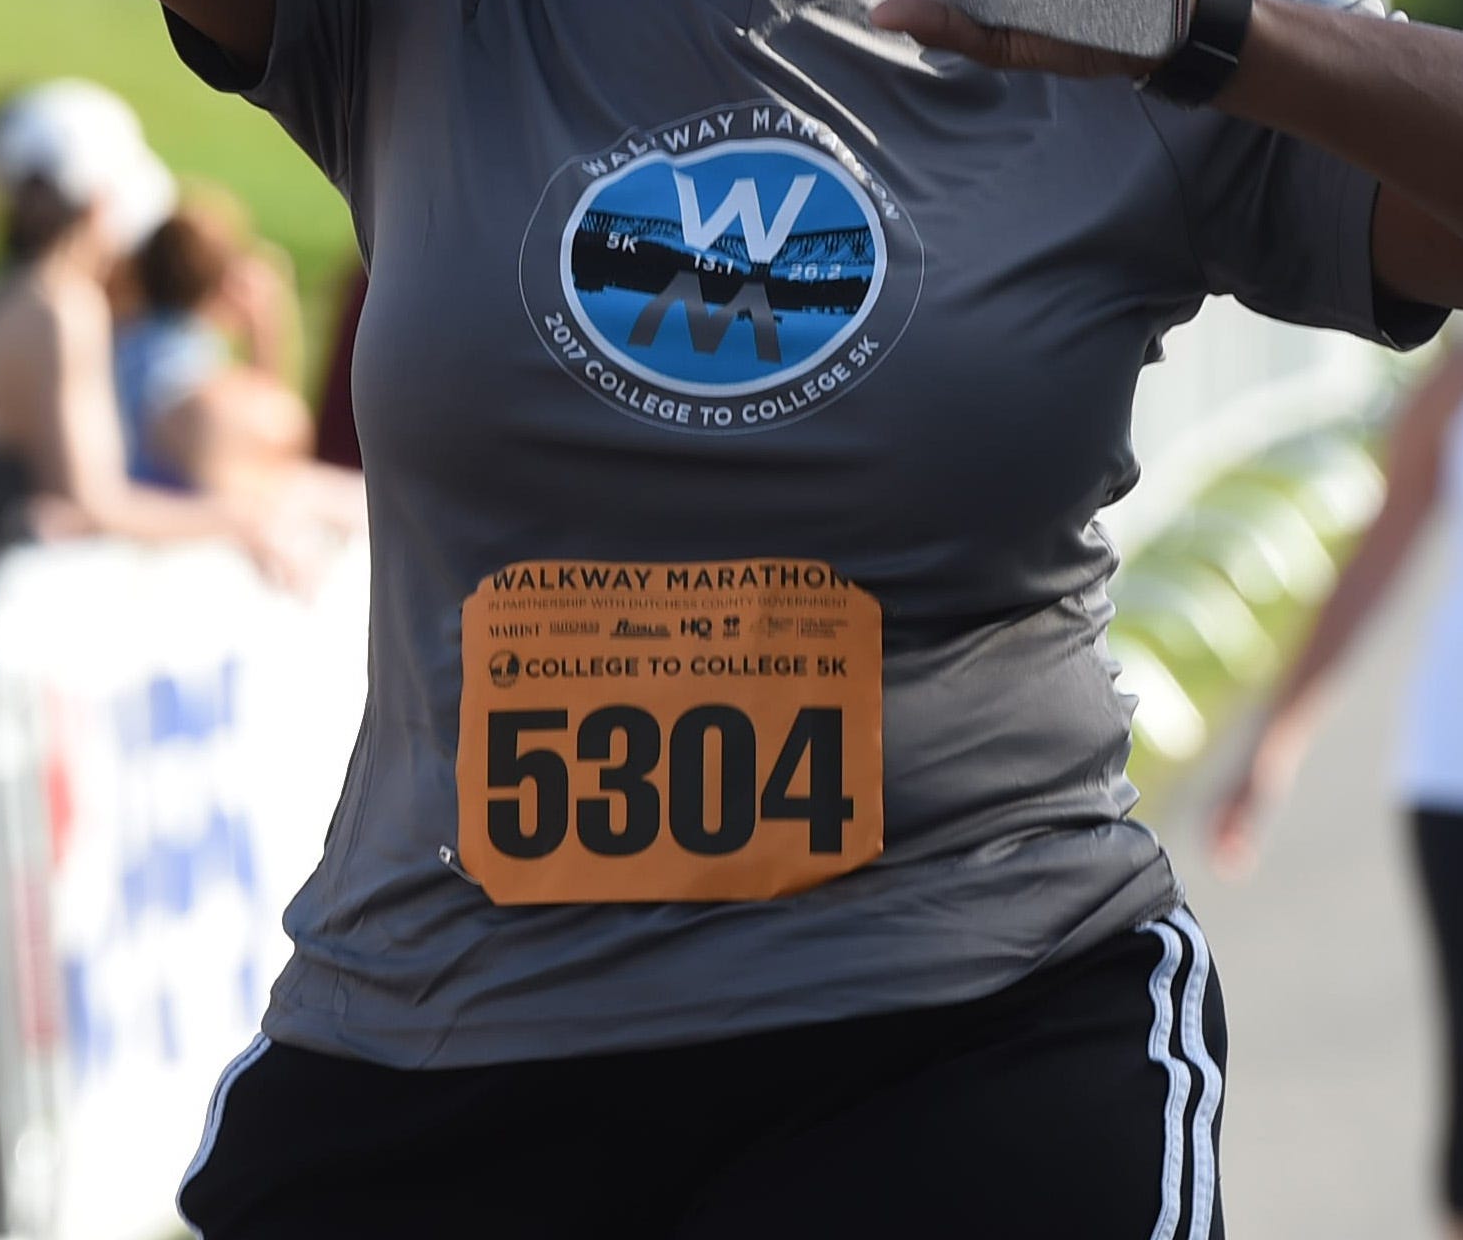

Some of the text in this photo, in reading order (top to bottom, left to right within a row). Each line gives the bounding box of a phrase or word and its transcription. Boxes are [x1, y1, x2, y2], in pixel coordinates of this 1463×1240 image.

[582, 106, 900, 220] WALWAY MARAON
[673, 168, 817, 263] W
[605, 231, 842, 282] 5K 13.1 26.2
[544, 312, 880, 427] 2017 COLLEGE TO COLLEGE 5K
[493, 565, 849, 592] WALKWAY MARATHON
[680, 616, 713, 639] HQ
[525, 655, 848, 678] COLLEGE TO COLLEGE 5K
[487, 702, 855, 861] 5304
